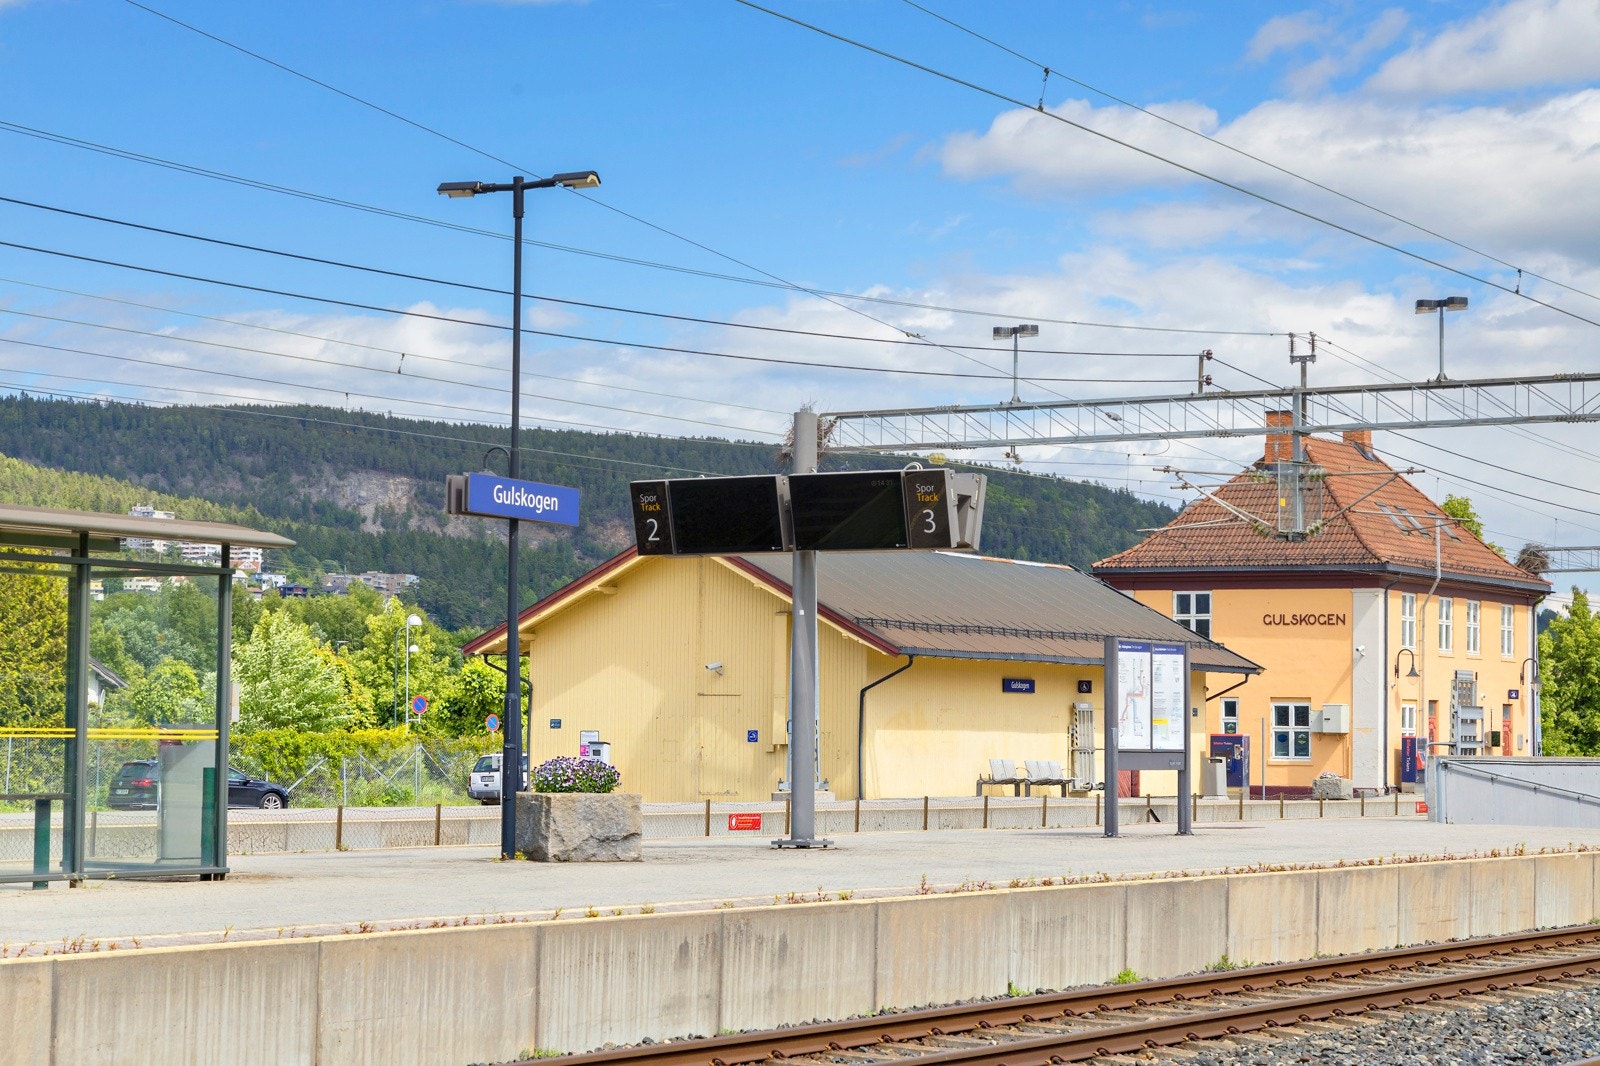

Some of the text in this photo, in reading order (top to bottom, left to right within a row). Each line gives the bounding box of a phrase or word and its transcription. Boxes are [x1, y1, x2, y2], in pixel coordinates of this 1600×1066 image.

[916, 483, 935, 494] Spor
[493, 484, 559, 513] Gulskogen
[639, 493, 657, 504] Spor
[916, 492, 939, 502] Track
[640, 502, 661, 512] Track
[922, 509, 936, 534] 3
[646, 518, 660, 541] 2
[1263, 613, 1346, 626] GULSKOGEN
[1010, 681, 1030, 691] Gulskogen
